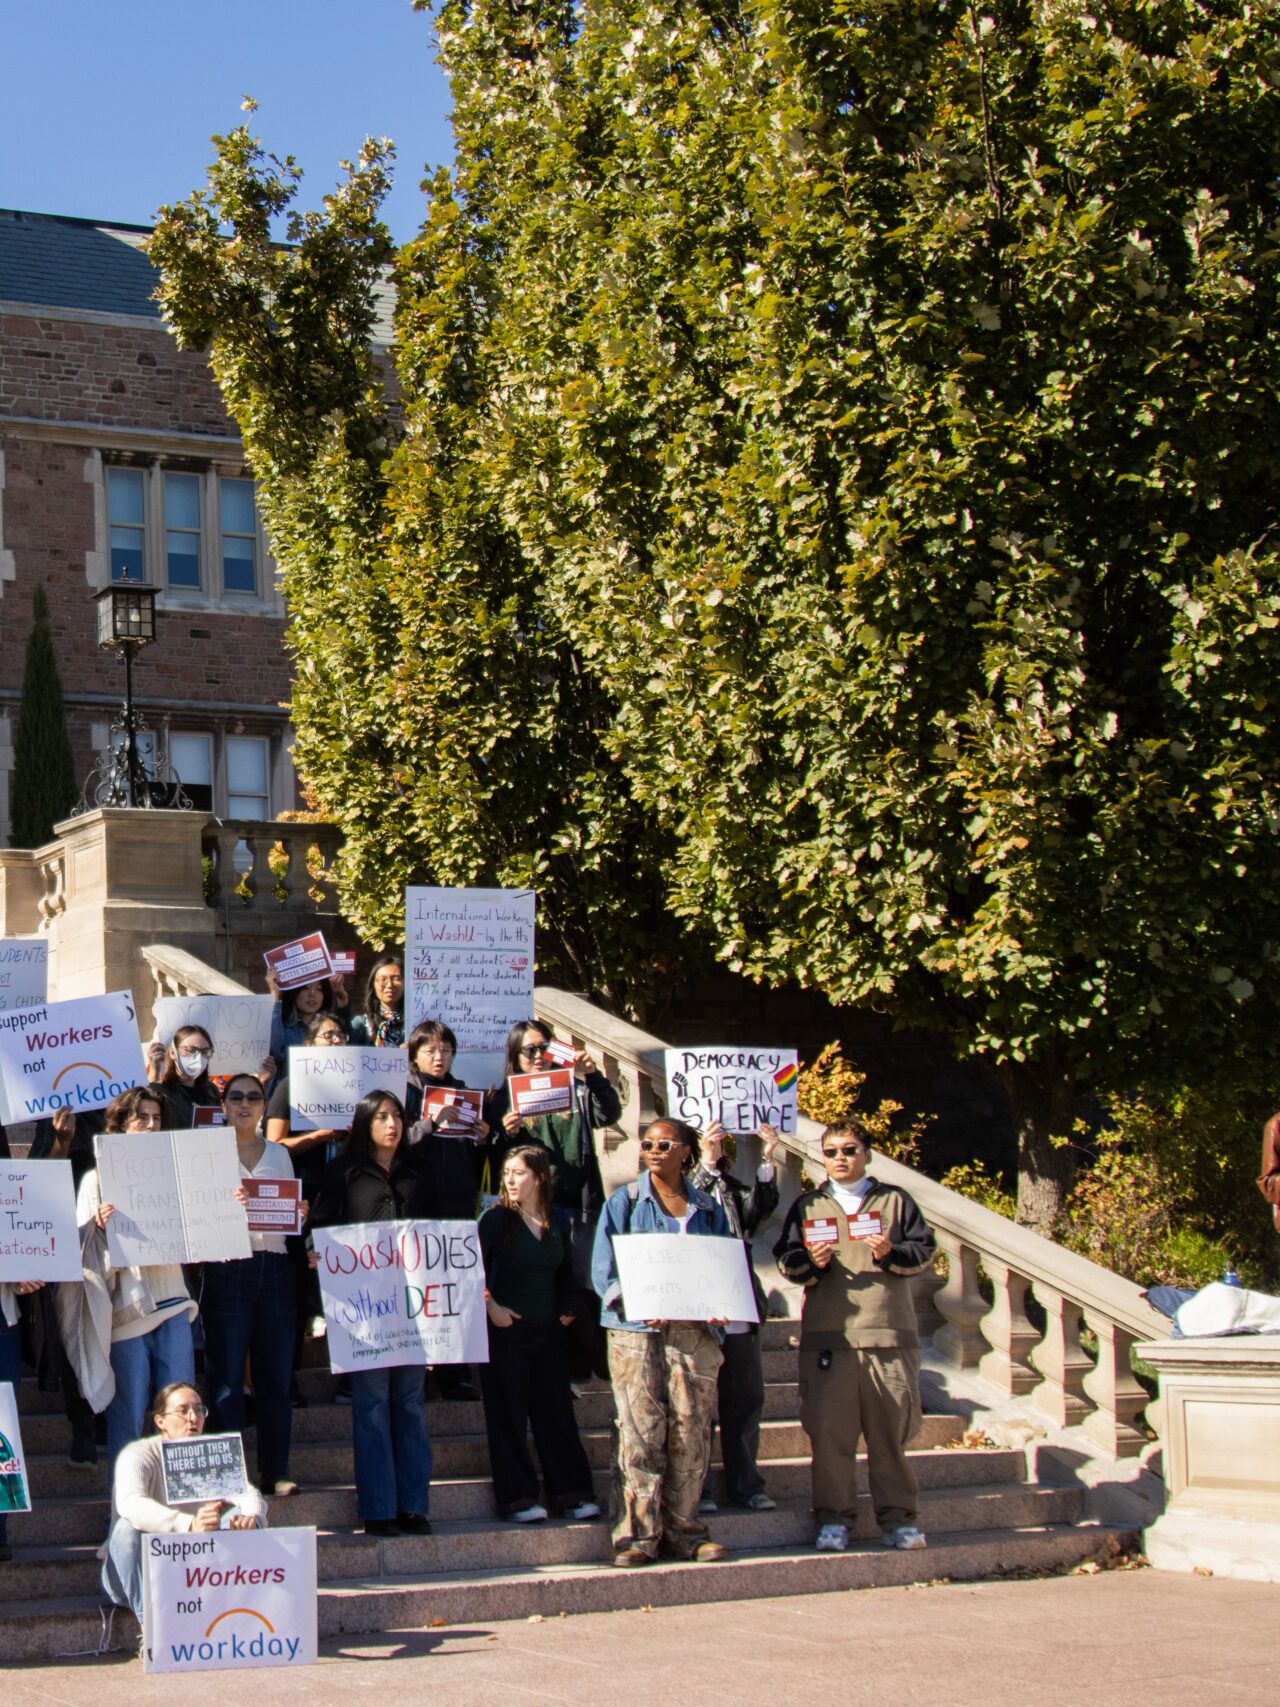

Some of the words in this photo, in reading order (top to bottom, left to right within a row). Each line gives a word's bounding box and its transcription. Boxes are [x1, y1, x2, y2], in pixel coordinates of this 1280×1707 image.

[26, 1025, 113, 1051] Workers
[215, 1039, 268, 1060] BORATE
[24, 1058, 45, 1074] not
[296, 1058, 355, 1076] TRANS
[360, 1055, 408, 1074] RIGHTS
[682, 1052, 780, 1073] DEMOCRACY
[342, 1079, 364, 1091] ARE
[701, 1075, 748, 1101] DIES
[754, 1079, 773, 1104] IN
[680, 1096, 792, 1133] SILENCE
[259, 1187, 279, 1195] STOP
[6, 1212, 53, 1235] Trump
[268, 1214, 295, 1222] TRUMP
[424, 1234, 478, 1272] DIES
[405, 1283, 460, 1319] DEI
[166, 1445, 204, 1459] WITHOUT
[207, 1442, 229, 1454] THEM
[167, 1459, 195, 1472] THERE
[198, 1457, 206, 1468] IS
[209, 1455, 220, 1466] NO
[223, 1453, 233, 1464] US
[151, 1538, 215, 1562] Support
[186, 1565, 285, 1588] Workers
[177, 1597, 202, 1614] not
[171, 1632, 300, 1662] workday
